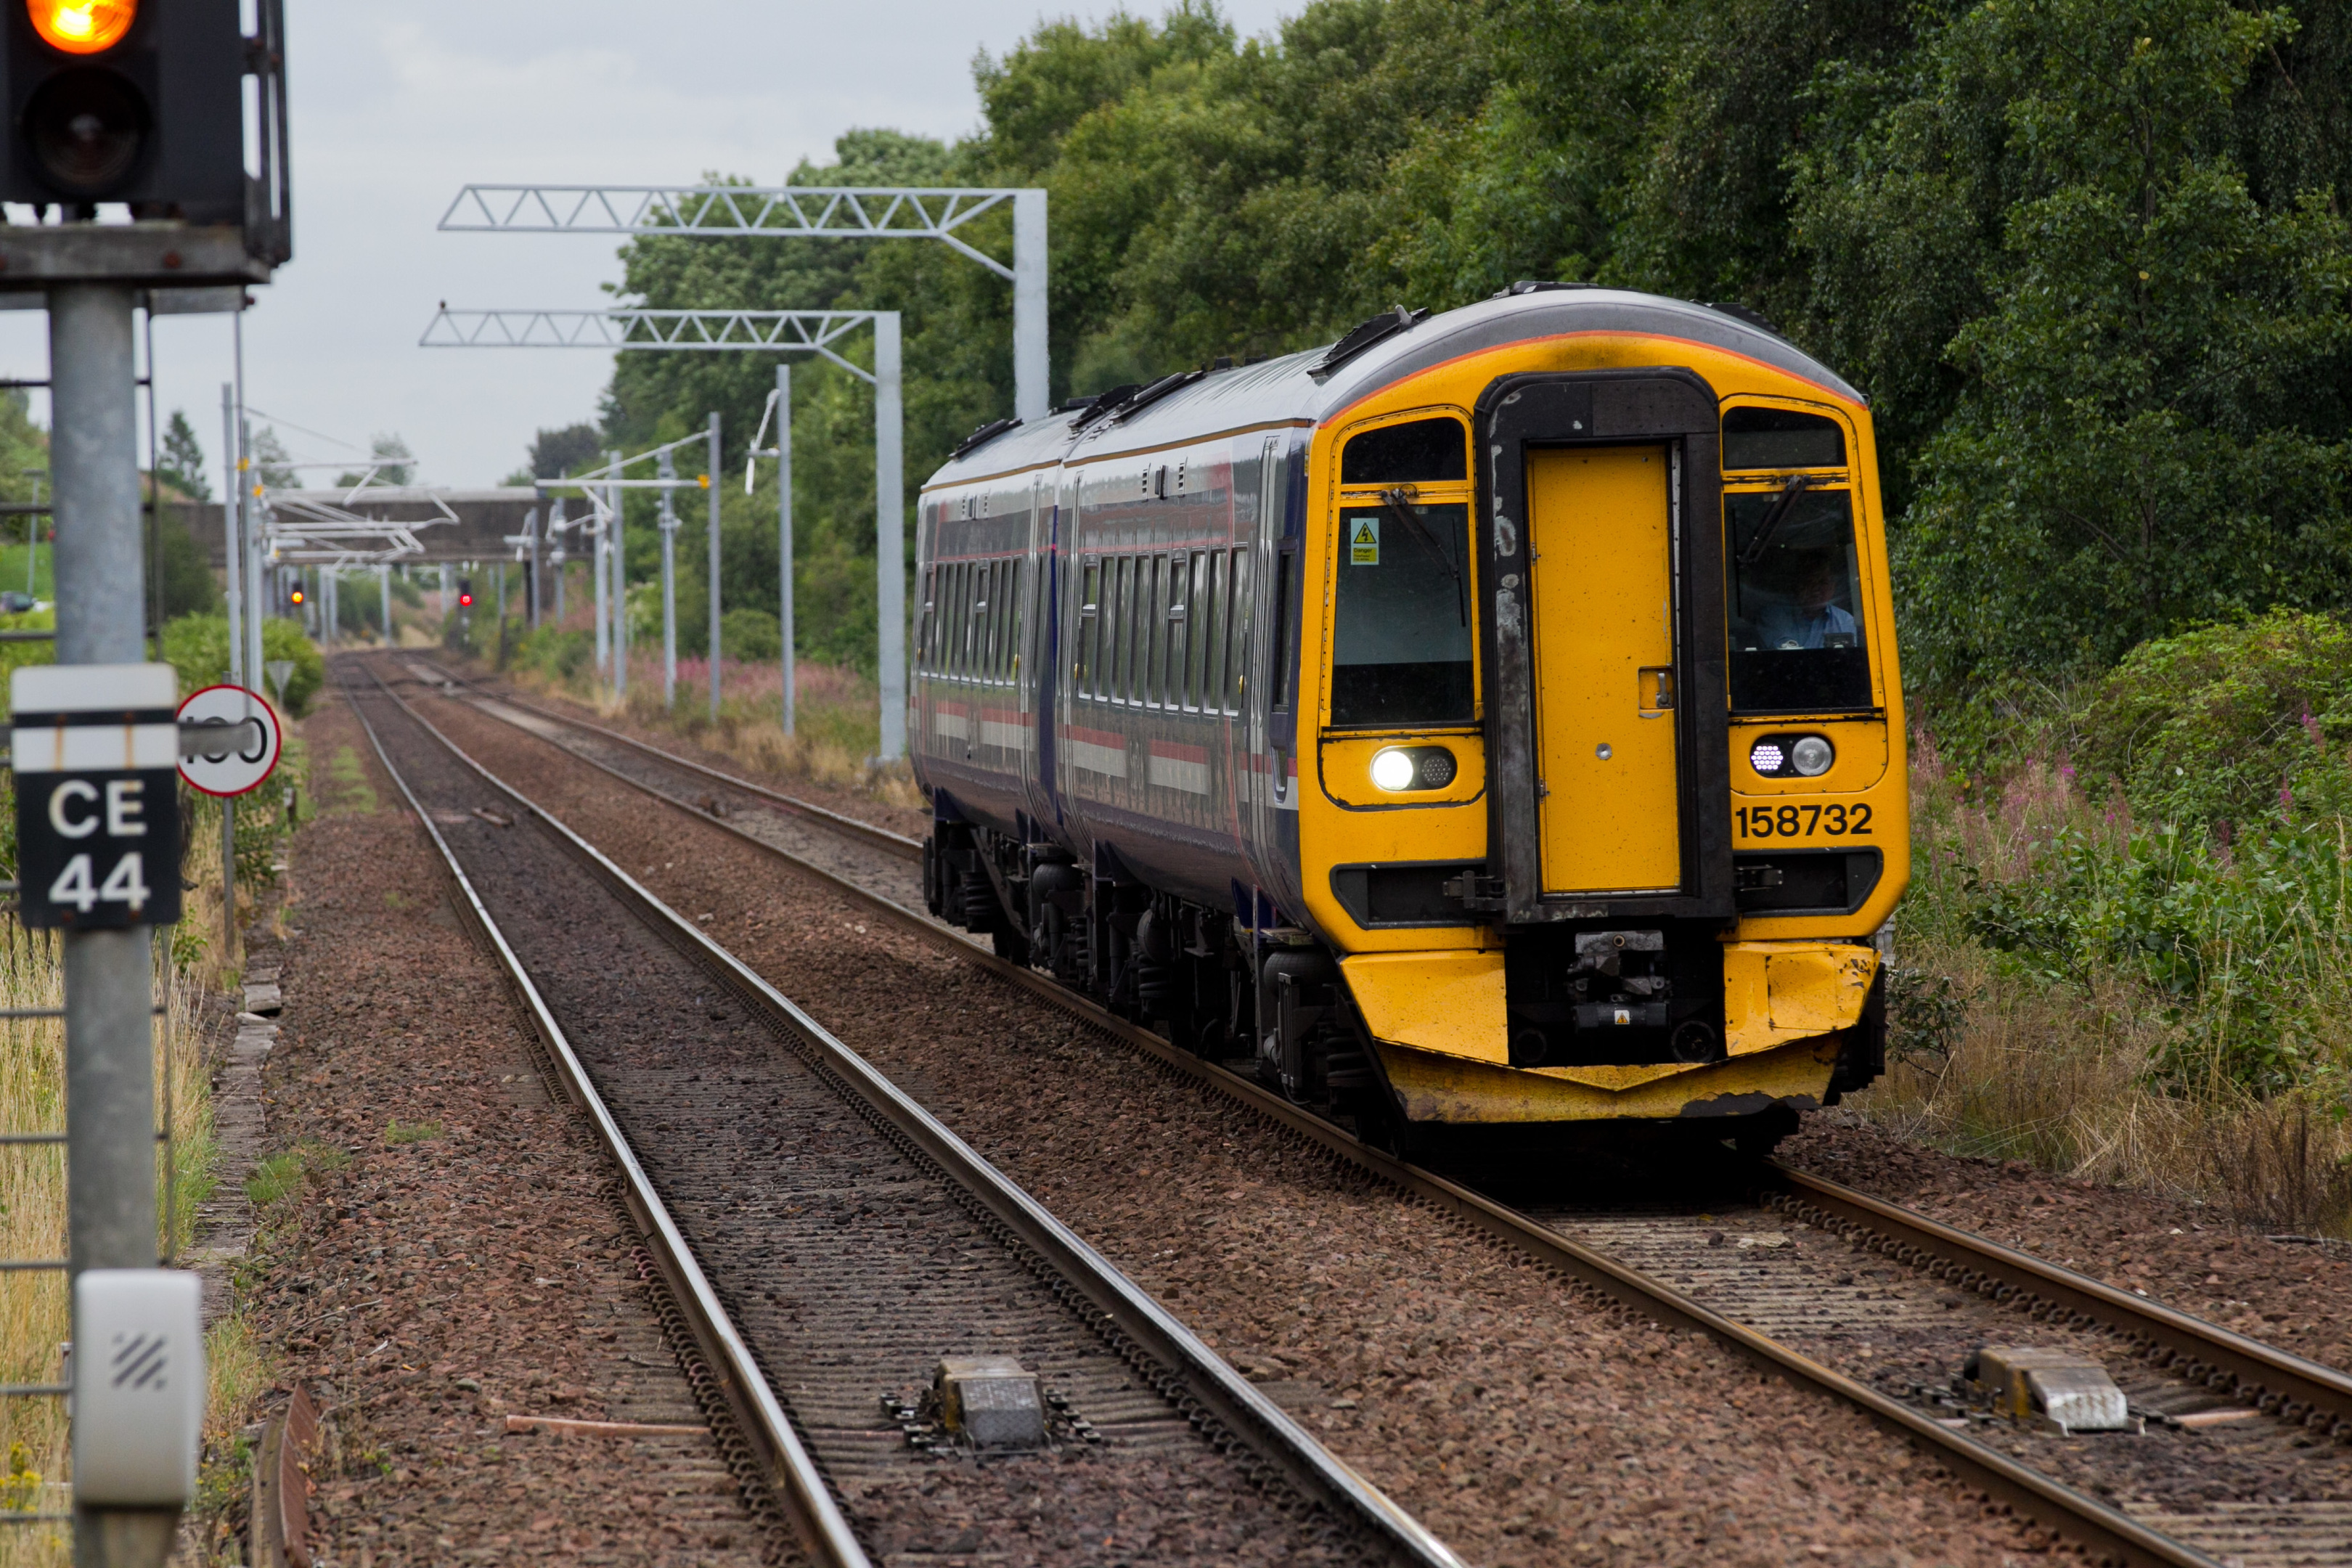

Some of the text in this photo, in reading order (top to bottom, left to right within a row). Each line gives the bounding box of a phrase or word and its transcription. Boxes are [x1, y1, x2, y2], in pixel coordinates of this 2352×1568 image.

[47, 778, 149, 839] CE
[1735, 802, 1873, 838] 158732
[47, 851, 151, 913] 44
